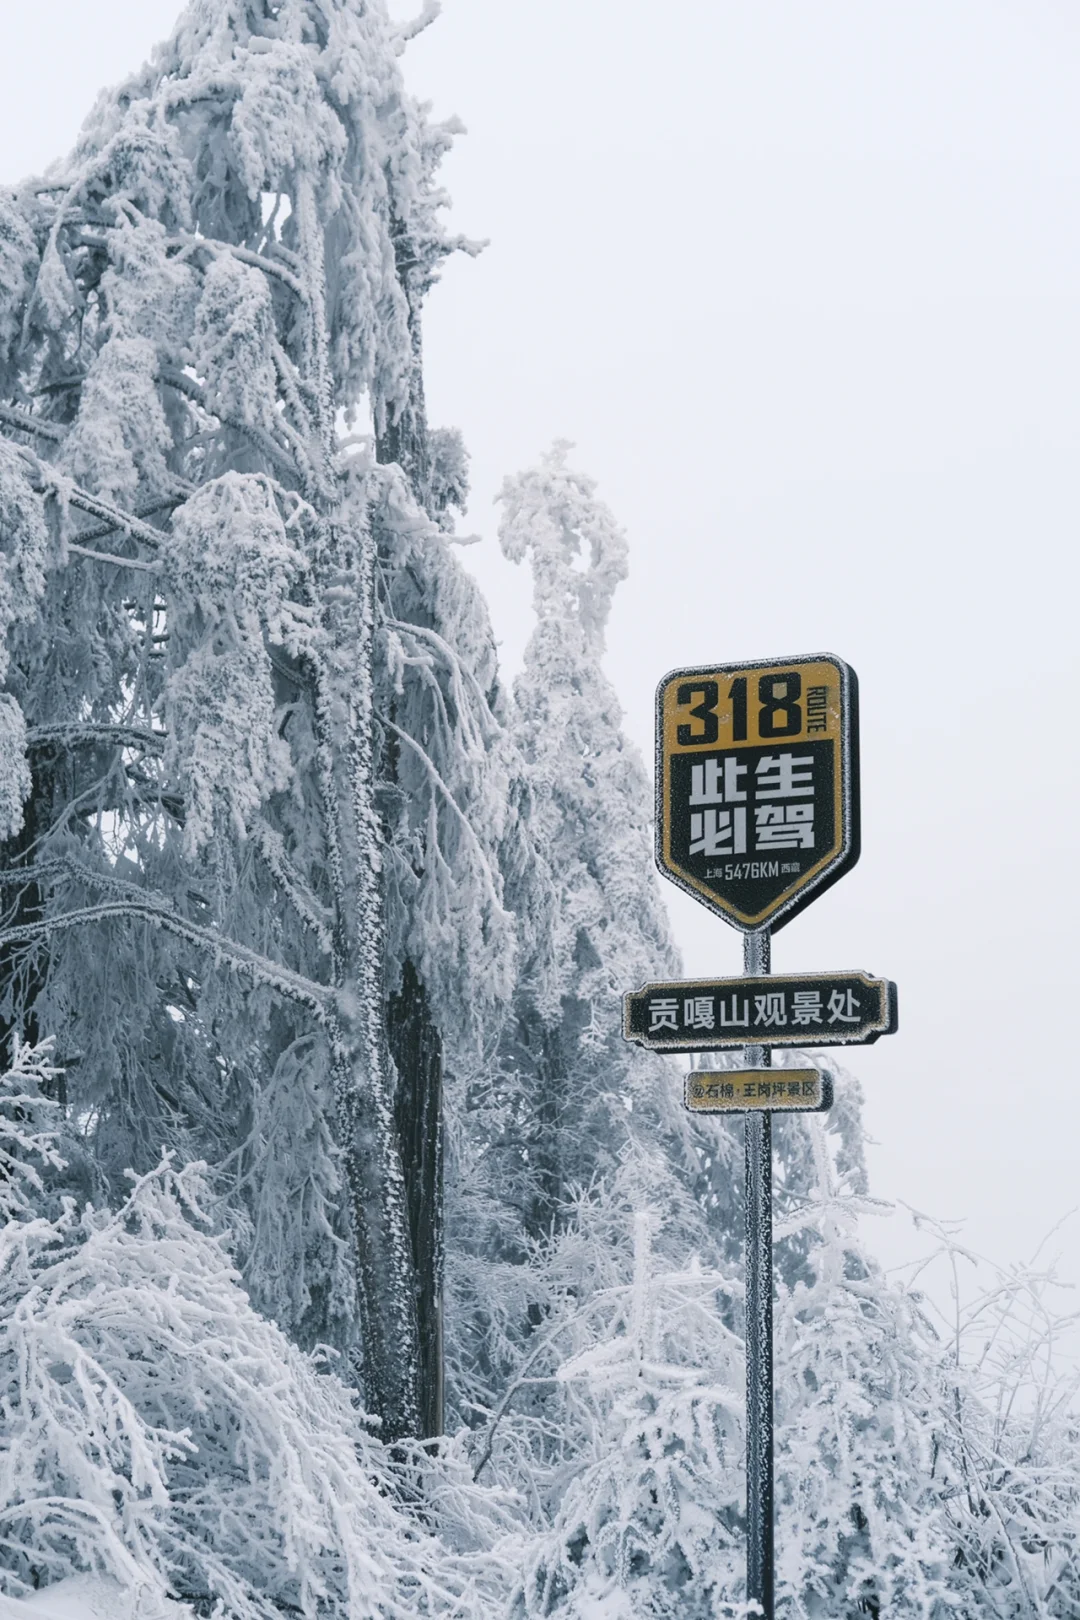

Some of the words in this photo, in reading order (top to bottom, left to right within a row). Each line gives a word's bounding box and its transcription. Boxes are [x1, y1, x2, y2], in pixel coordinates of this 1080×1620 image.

[677, 672, 802, 746] 318
[806, 686, 827, 734] ROUTE
[689, 753, 814, 806] 此生
[689, 803, 815, 857] 必驾
[704, 868, 723, 879] 上海
[725, 861, 779, 880] 5476KM
[648, 989, 861, 1032] 贡嘎山观景处
